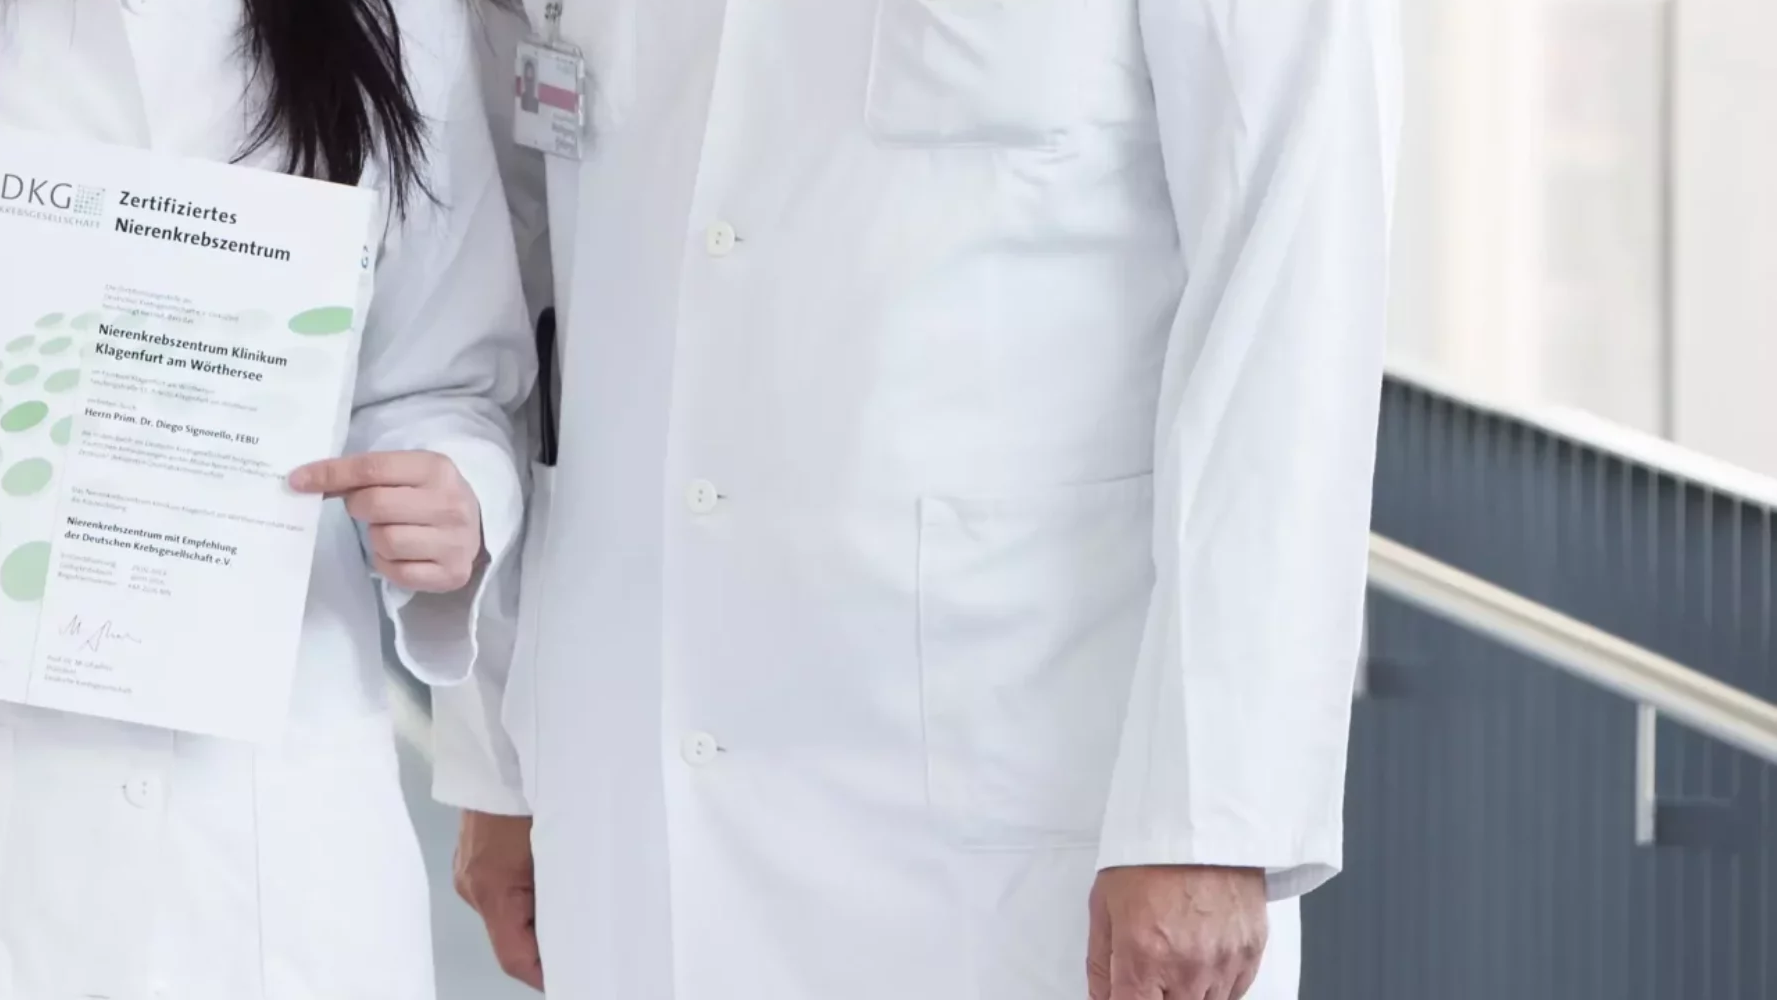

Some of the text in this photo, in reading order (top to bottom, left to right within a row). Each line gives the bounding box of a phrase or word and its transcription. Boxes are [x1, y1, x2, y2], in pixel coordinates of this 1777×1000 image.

[1, 173, 72, 210] DKG
[119, 191, 236, 224] Zertifiziertes
[115, 218, 290, 261] Nierenkrebszentrum
[96, 343, 262, 381] Klagenfurt am Wörthersee
[99, 324, 287, 366] Nierenkrebszentrum Klinikum
[85, 407, 112, 419] Herrn
[156, 419, 184, 433] Diego
[236, 433, 260, 444] FEBU
[64, 529, 81, 539] der
[82, 533, 131, 549] Deutschen
[134, 542, 213, 564] Krebsgesellschaft
[67, 516, 237, 555] Nierenkrebszentrum mit Empfehlung
